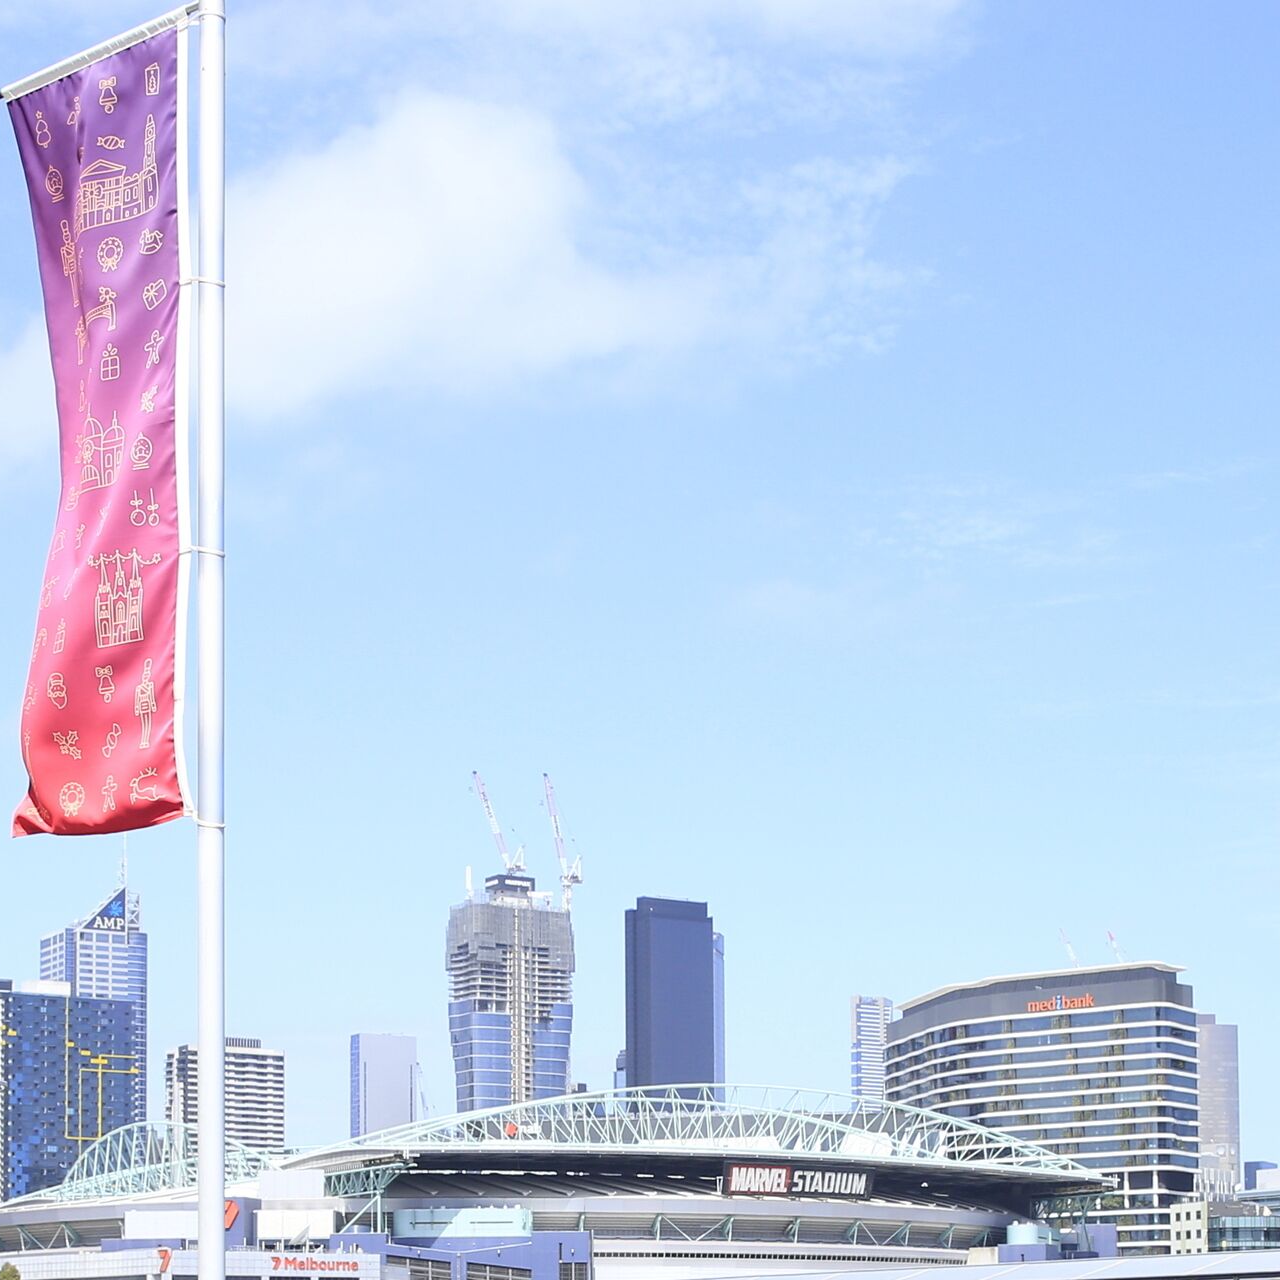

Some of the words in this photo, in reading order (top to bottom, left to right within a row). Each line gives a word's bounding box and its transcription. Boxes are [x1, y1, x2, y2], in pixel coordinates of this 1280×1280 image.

[94, 916, 125, 930] AMP
[1027, 993, 1094, 1012] medibank
[730, 1166, 787, 1193] MARVEL
[792, 1170, 866, 1195] STADIUM
[283, 1257, 359, 1272] Melbourne
